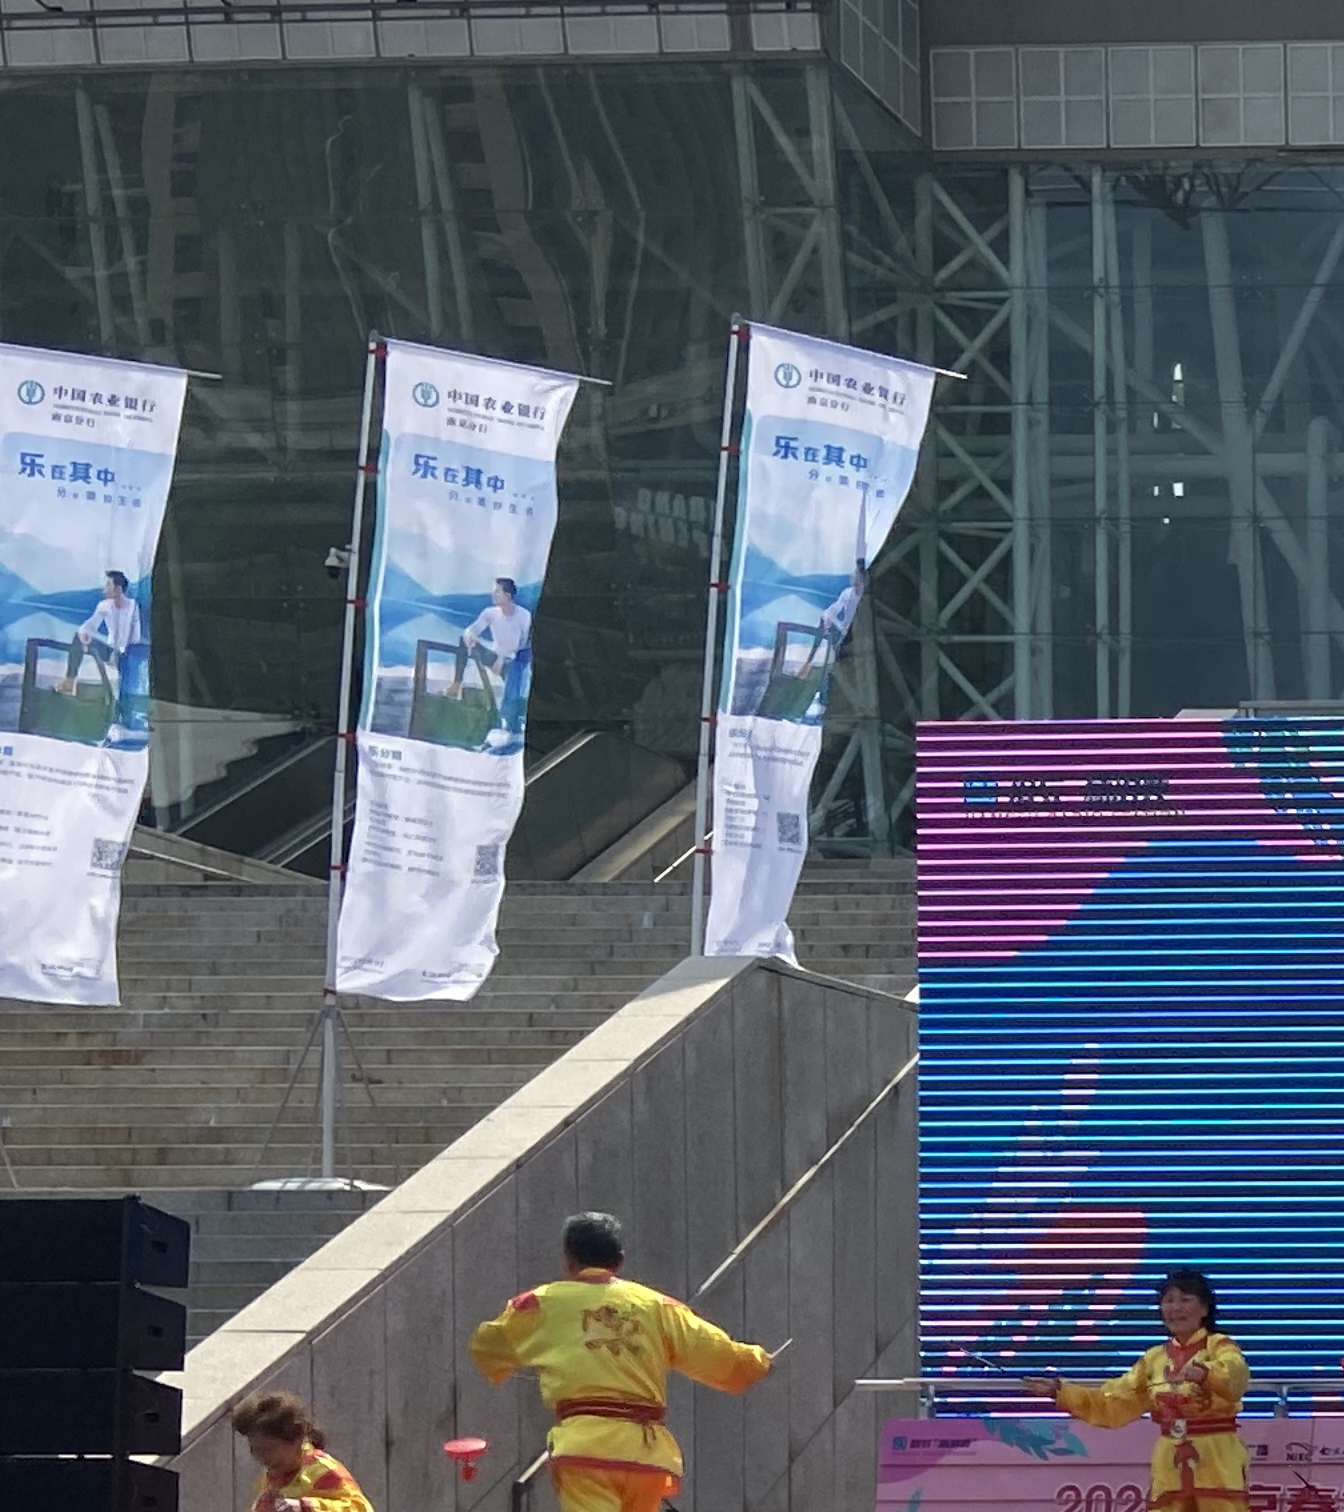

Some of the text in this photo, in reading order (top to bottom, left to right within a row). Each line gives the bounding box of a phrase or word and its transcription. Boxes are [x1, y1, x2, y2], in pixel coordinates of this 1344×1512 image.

[53, 385, 158, 413] 中国农业银行
[447, 388, 547, 421] 中国农业银行
[809, 369, 907, 406] 中国农业银行
[18, 452, 116, 487] 乐在其中
[771, 435, 869, 473] 乐在其中
[411, 453, 505, 493] 乐在其中
